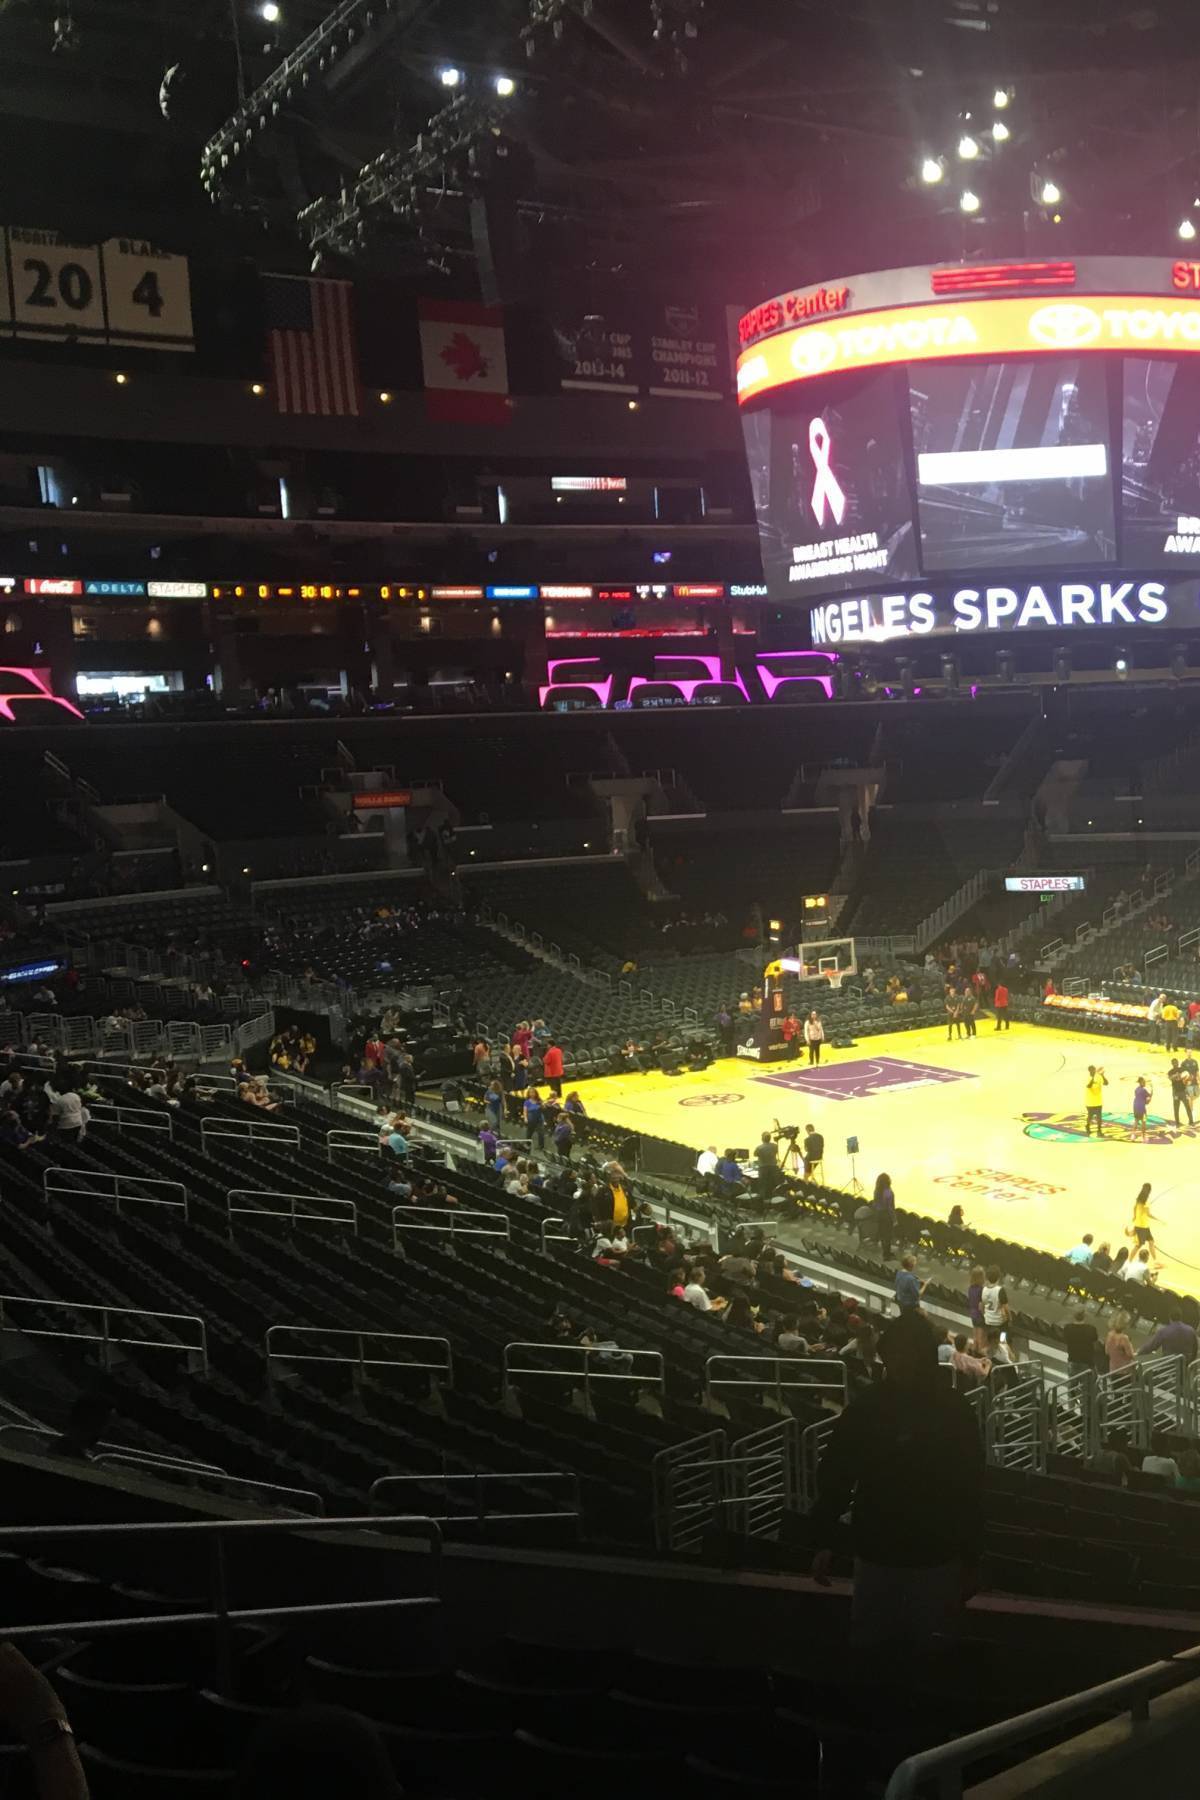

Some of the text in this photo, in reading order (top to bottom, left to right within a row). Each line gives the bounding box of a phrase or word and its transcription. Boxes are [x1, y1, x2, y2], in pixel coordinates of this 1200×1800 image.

[24, 259, 93, 310] 20
[132, 271, 164, 317] 4
[783, 287, 848, 320] Center
[651, 336, 693, 350] STANLEY
[837, 316, 978, 356] TOYOTA
[652, 350, 717, 367] CHAMPIONS
[664, 368, 709, 386] 2011-12
[793, 532, 878, 563] BREAST HEALTH
[101, 584, 145, 594] DELTA
[953, 583, 1168, 631] SPARKS
[1020, 879, 1069, 890] STAPLES
[932, 1175, 1029, 1202] Center
[965, 1168, 1067, 1195] STAPLES
